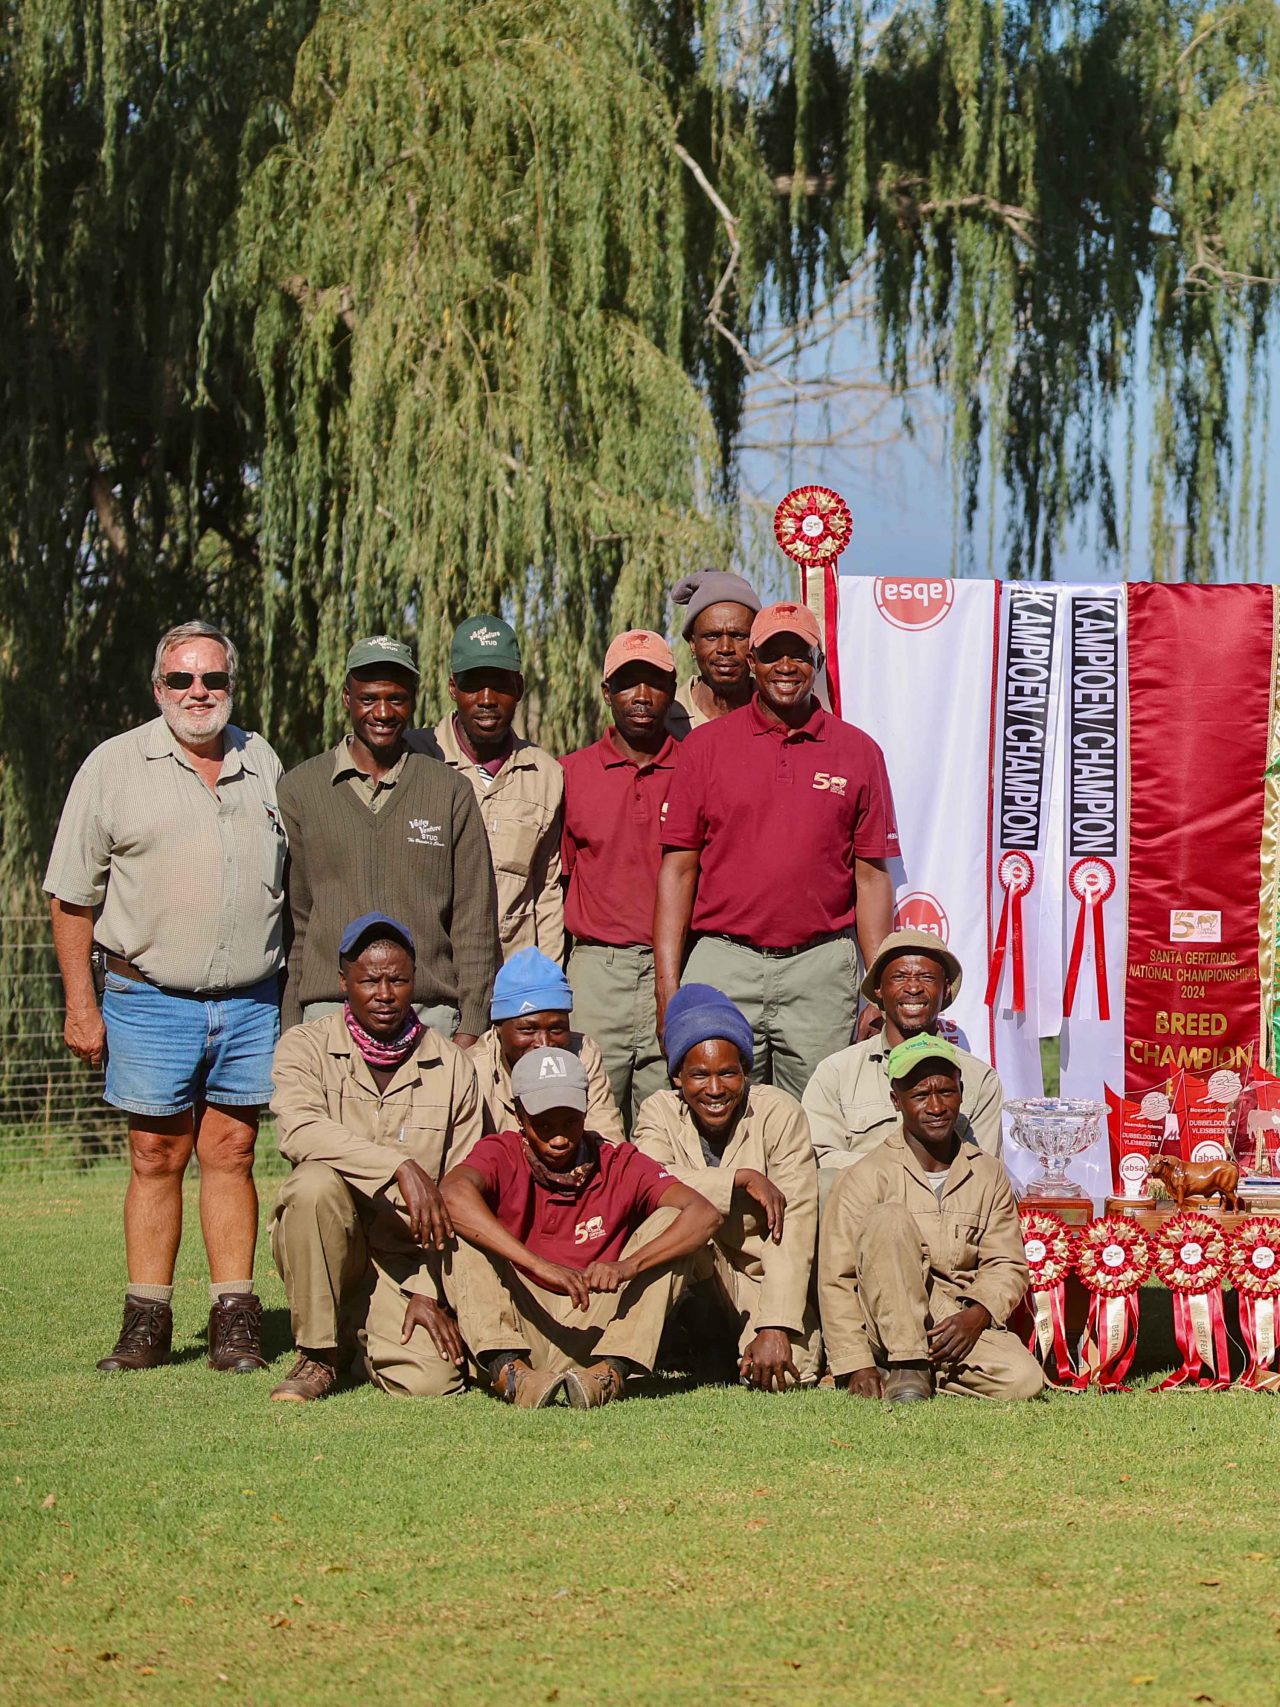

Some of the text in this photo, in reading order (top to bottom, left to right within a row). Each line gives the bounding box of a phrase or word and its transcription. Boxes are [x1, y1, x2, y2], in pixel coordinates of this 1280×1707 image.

[884, 582, 945, 608] absa
[1002, 592, 1054, 846] KAMPIOEN/CHAMPION
[1072, 600, 1116, 852] KAMPIOEN/CHAMPION
[418, 825, 442, 835] Venture
[1149, 948, 1237, 966] SANTA GERTRUDIS
[1129, 963, 1258, 982] NATIONAL CHAMPIONSHIPS
[1181, 985, 1205, 999] 2024
[1155, 1010, 1228, 1036] BREED
[1129, 1040, 1253, 1070] CHAMPION
[1197, 1153, 1222, 1161] absa
[1124, 1164, 1144, 1172] absa
[1040, 1318, 1049, 1334] BEST
[1110, 1324, 1119, 1340] BEST
[1196, 1320, 1207, 1339] BEST
